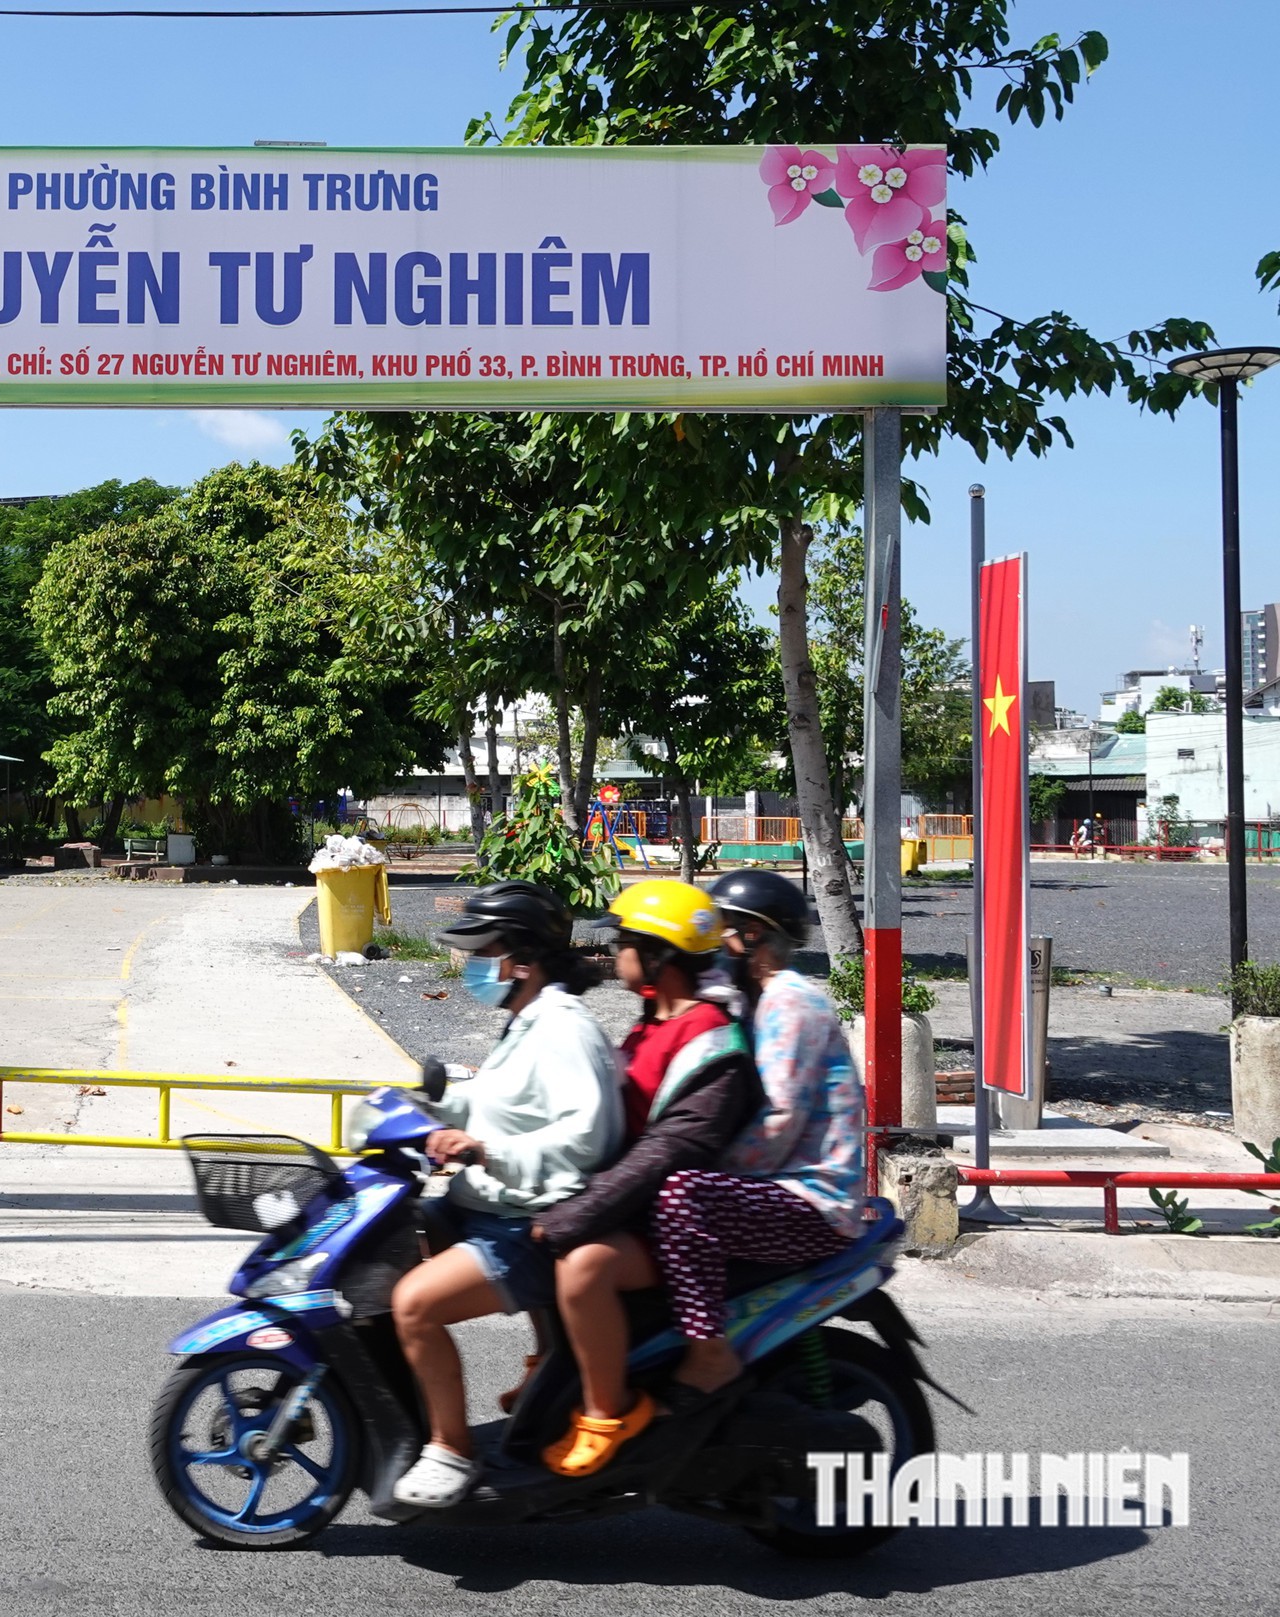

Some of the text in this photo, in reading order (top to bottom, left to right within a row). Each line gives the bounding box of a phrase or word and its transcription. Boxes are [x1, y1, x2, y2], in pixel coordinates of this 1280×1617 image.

[8, 163, 175, 210] PHƯỜNG
[191, 165, 288, 210] BÌNH
[303, 170, 438, 211] TRƯNG
[209, 244, 313, 326] TƯ
[334, 236, 650, 327] NGHIÊM
[7, 347, 52, 375] CHỈ:
[60, 346, 90, 375] SỐ
[97, 354, 123, 375] 27
[132, 346, 224, 376] NGUYỄN
[231, 352, 261, 375] TƯ
[267, 351, 364, 378] NGHIÊM,
[372, 355, 417, 376] KHU
[426, 347, 471, 376] PHỐ
[479, 355, 512, 378] 33,
[521, 355, 538, 376] P.
[546, 351, 601, 376] BÌNH
[609, 353, 691, 378] TRƯNG,
[699, 355, 729, 377] TP.
[738, 348, 767, 376] HỒ
[776, 350, 814, 377] CHÍ
[822, 355, 884, 377] MINH
